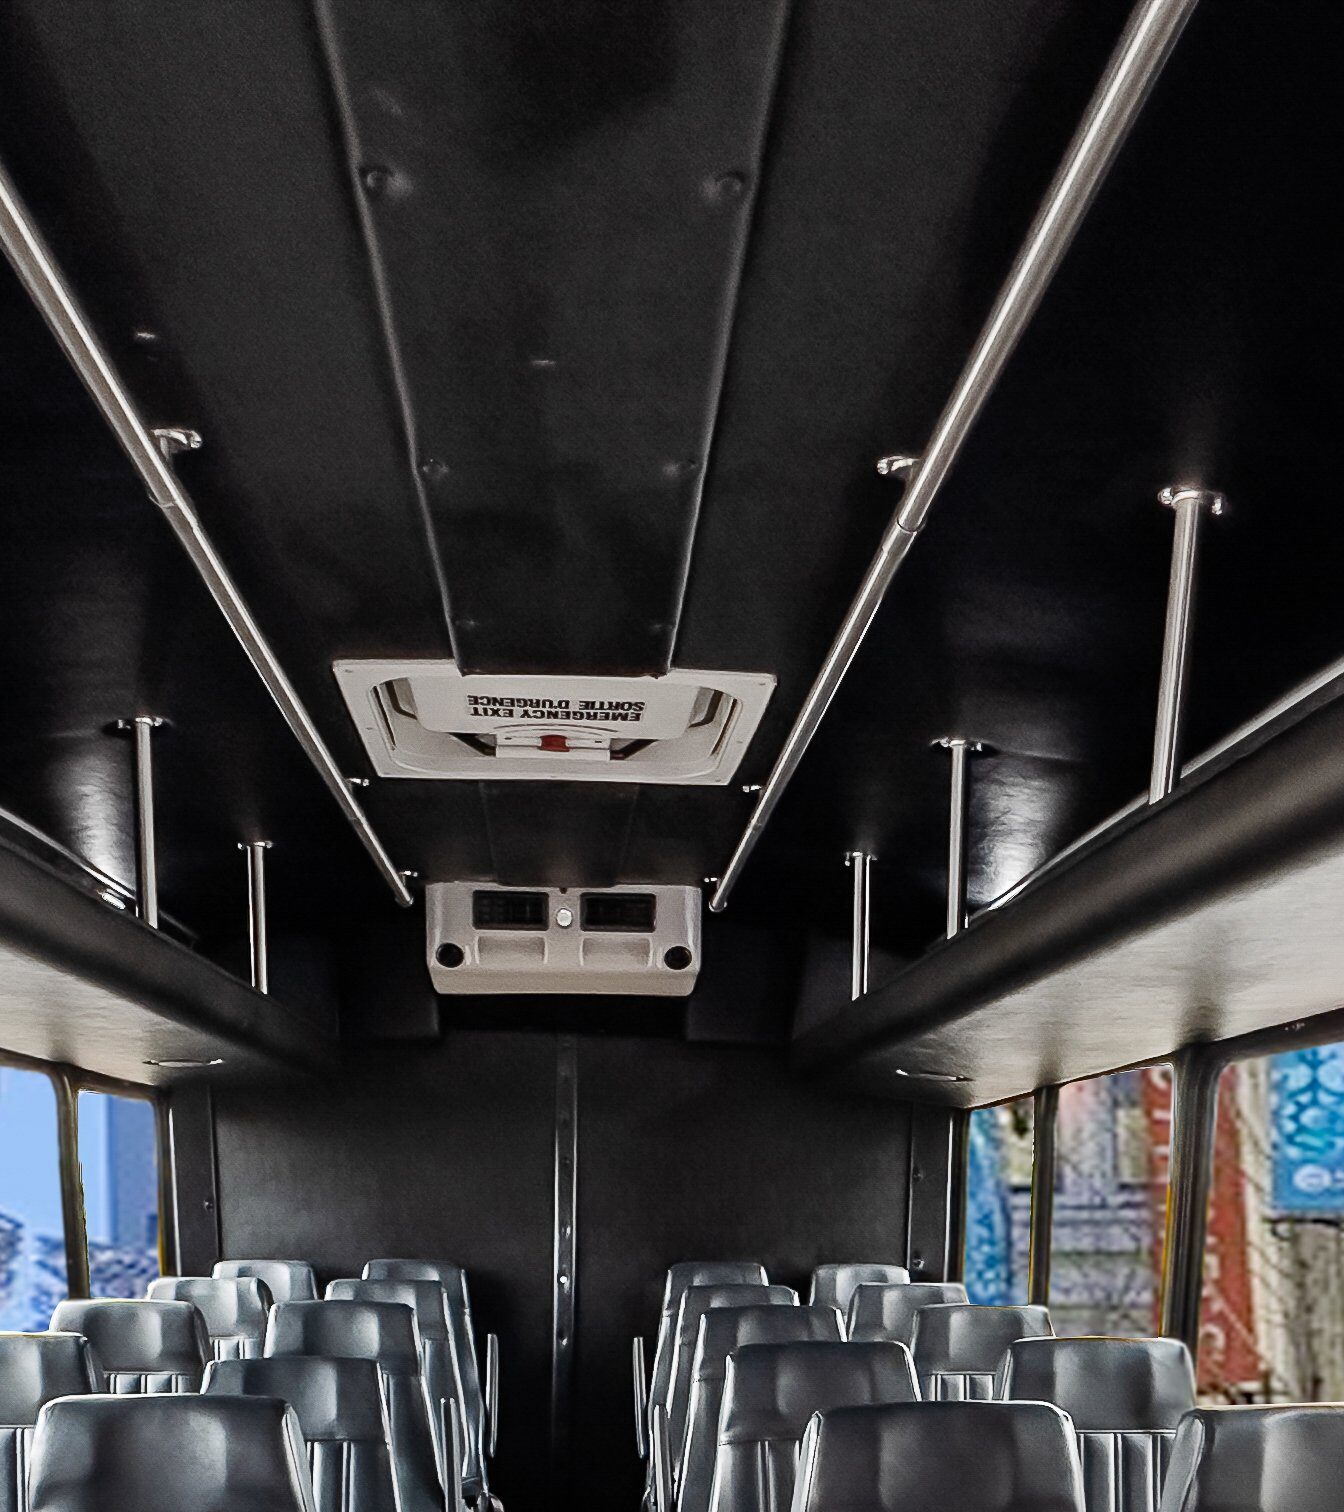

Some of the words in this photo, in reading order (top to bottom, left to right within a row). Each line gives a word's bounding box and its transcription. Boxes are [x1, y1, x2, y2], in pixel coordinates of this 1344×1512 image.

[467, 694, 570, 709] D'URGENCE
[579, 700, 646, 711] SORTIE
[470, 707, 514, 718] EXIT
[520, 709, 642, 722] EMERGENCY
